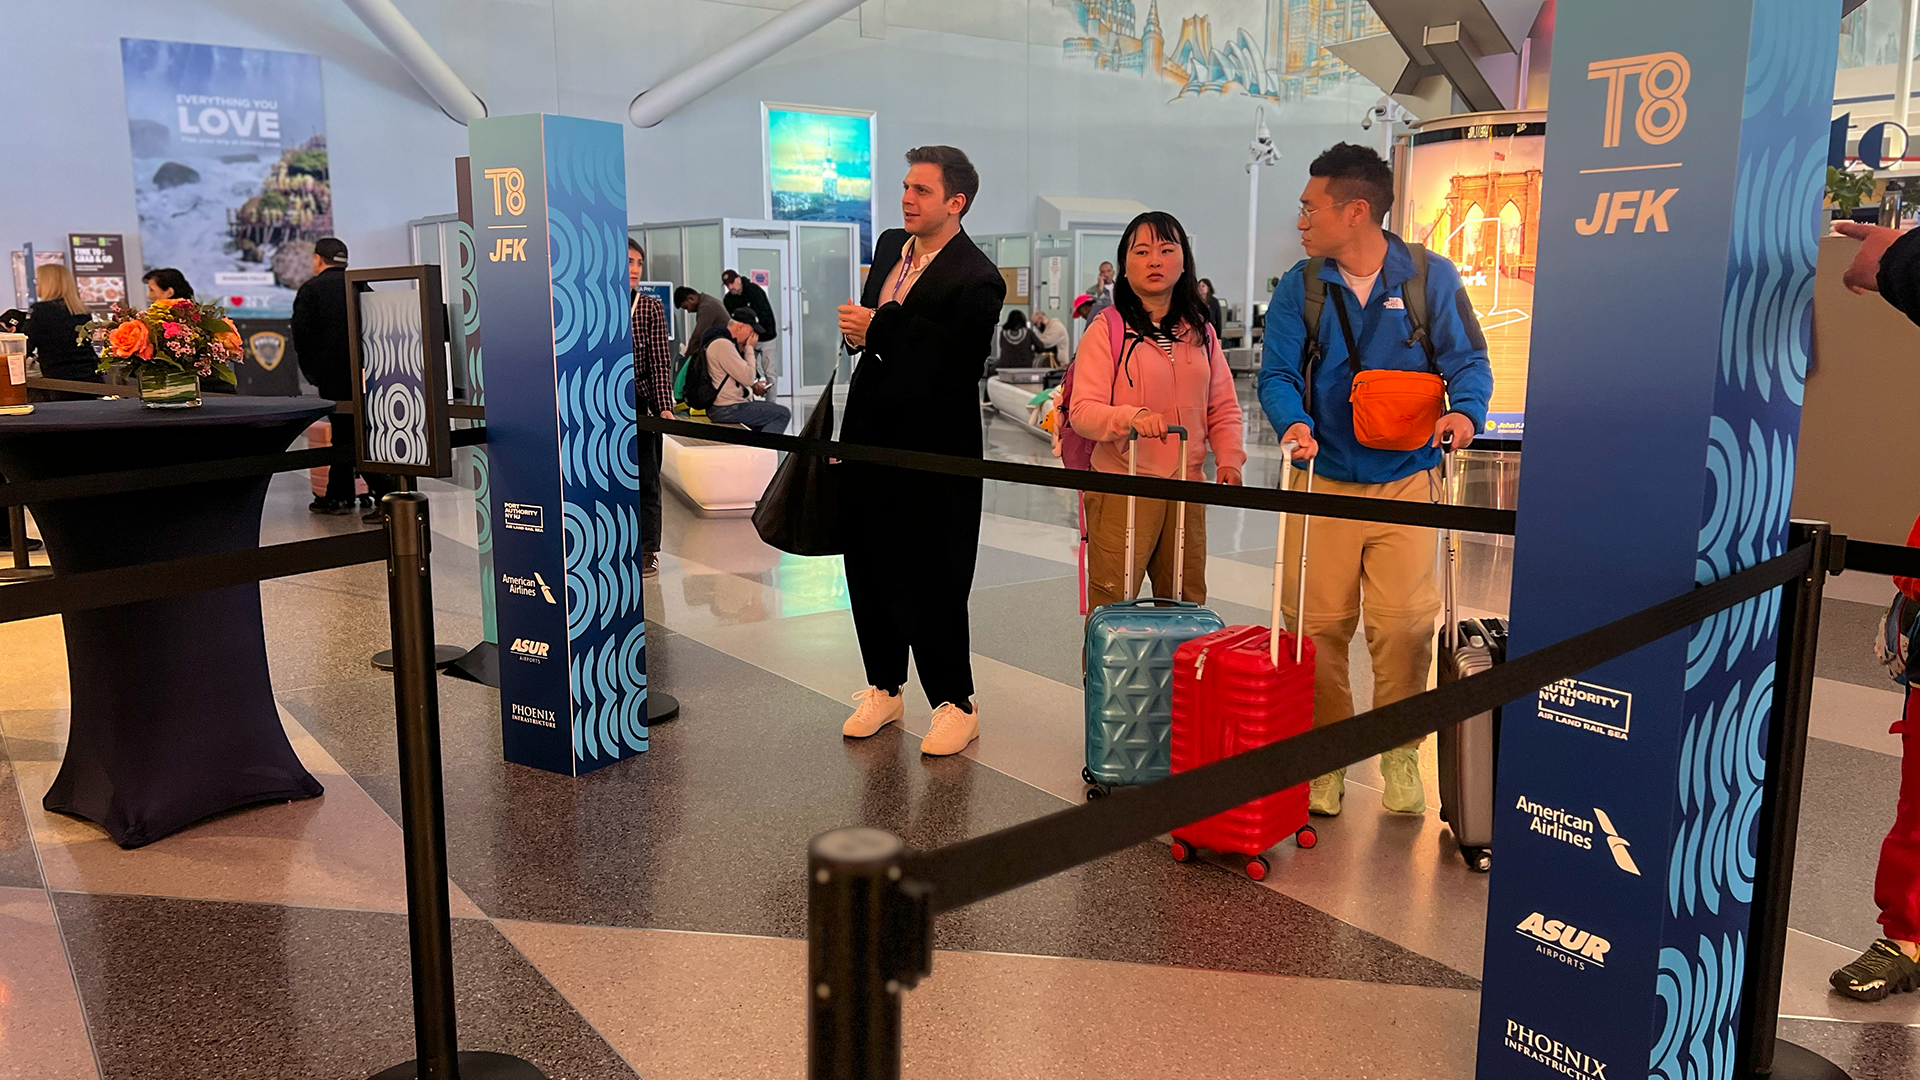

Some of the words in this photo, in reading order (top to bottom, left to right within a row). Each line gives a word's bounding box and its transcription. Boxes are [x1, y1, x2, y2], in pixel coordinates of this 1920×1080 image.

[176, 94, 251, 108] EVERYTHING
[253, 99, 278, 110] YOU
[1587, 51, 1691, 148] T8
[177, 105, 281, 139] LOVE
[484, 167, 526, 216] T8
[1575, 188, 1680, 236] JFK
[73, 248, 91, 256] TIME
[74, 255, 95, 263] GRAB
[102, 255, 114, 264] GO
[489, 238, 528, 262] JFK
[245, 295, 271, 308] NY
[504, 508, 538, 516] AUTHORITY
[502, 574, 536, 587] American
[509, 584, 536, 597] Airlines
[510, 638, 550, 657] ASUR
[519, 656, 541, 664] AIRPORTS
[1539, 690, 1559, 702] NY
[1559, 696, 1575, 707] NJ
[511, 714, 556, 728] INFRASTRUCTURE
[512, 703, 556, 722] PHOENIX
[1538, 711, 1553, 720] AIR
[1555, 715, 1582, 728] LAND
[1583, 723, 1606, 735] RAIL
[1607, 729, 1628, 741] SEA
[1515, 795, 1594, 834] American
[1529, 816, 1593, 850] Airlines
[1516, 911, 1611, 963] ASUR
[1535, 944, 1586, 971] AIRPORTS
[1506, 1018, 1607, 1080] PHOENIX
